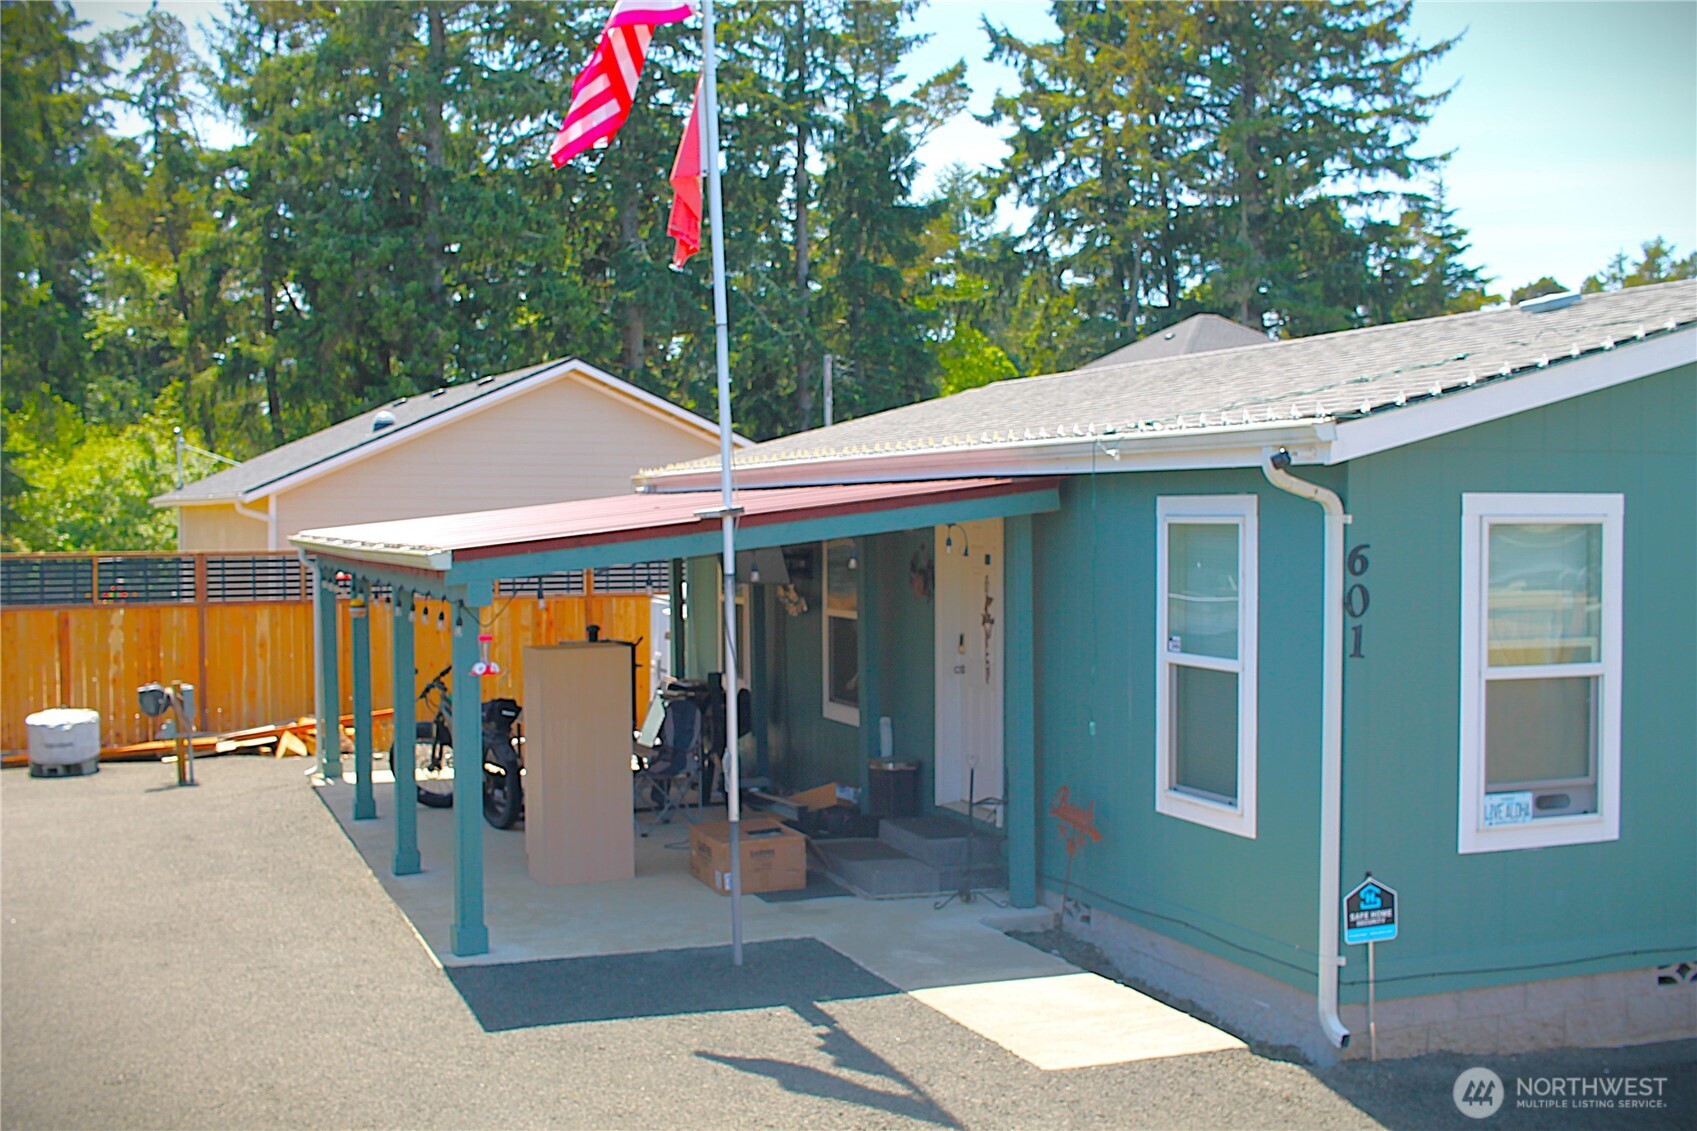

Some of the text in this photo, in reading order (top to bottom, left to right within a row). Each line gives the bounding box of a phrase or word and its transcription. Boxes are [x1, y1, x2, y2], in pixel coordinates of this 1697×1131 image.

[1346, 544, 1371, 658] 601
[1349, 908, 1393, 922] SAFE HOME
